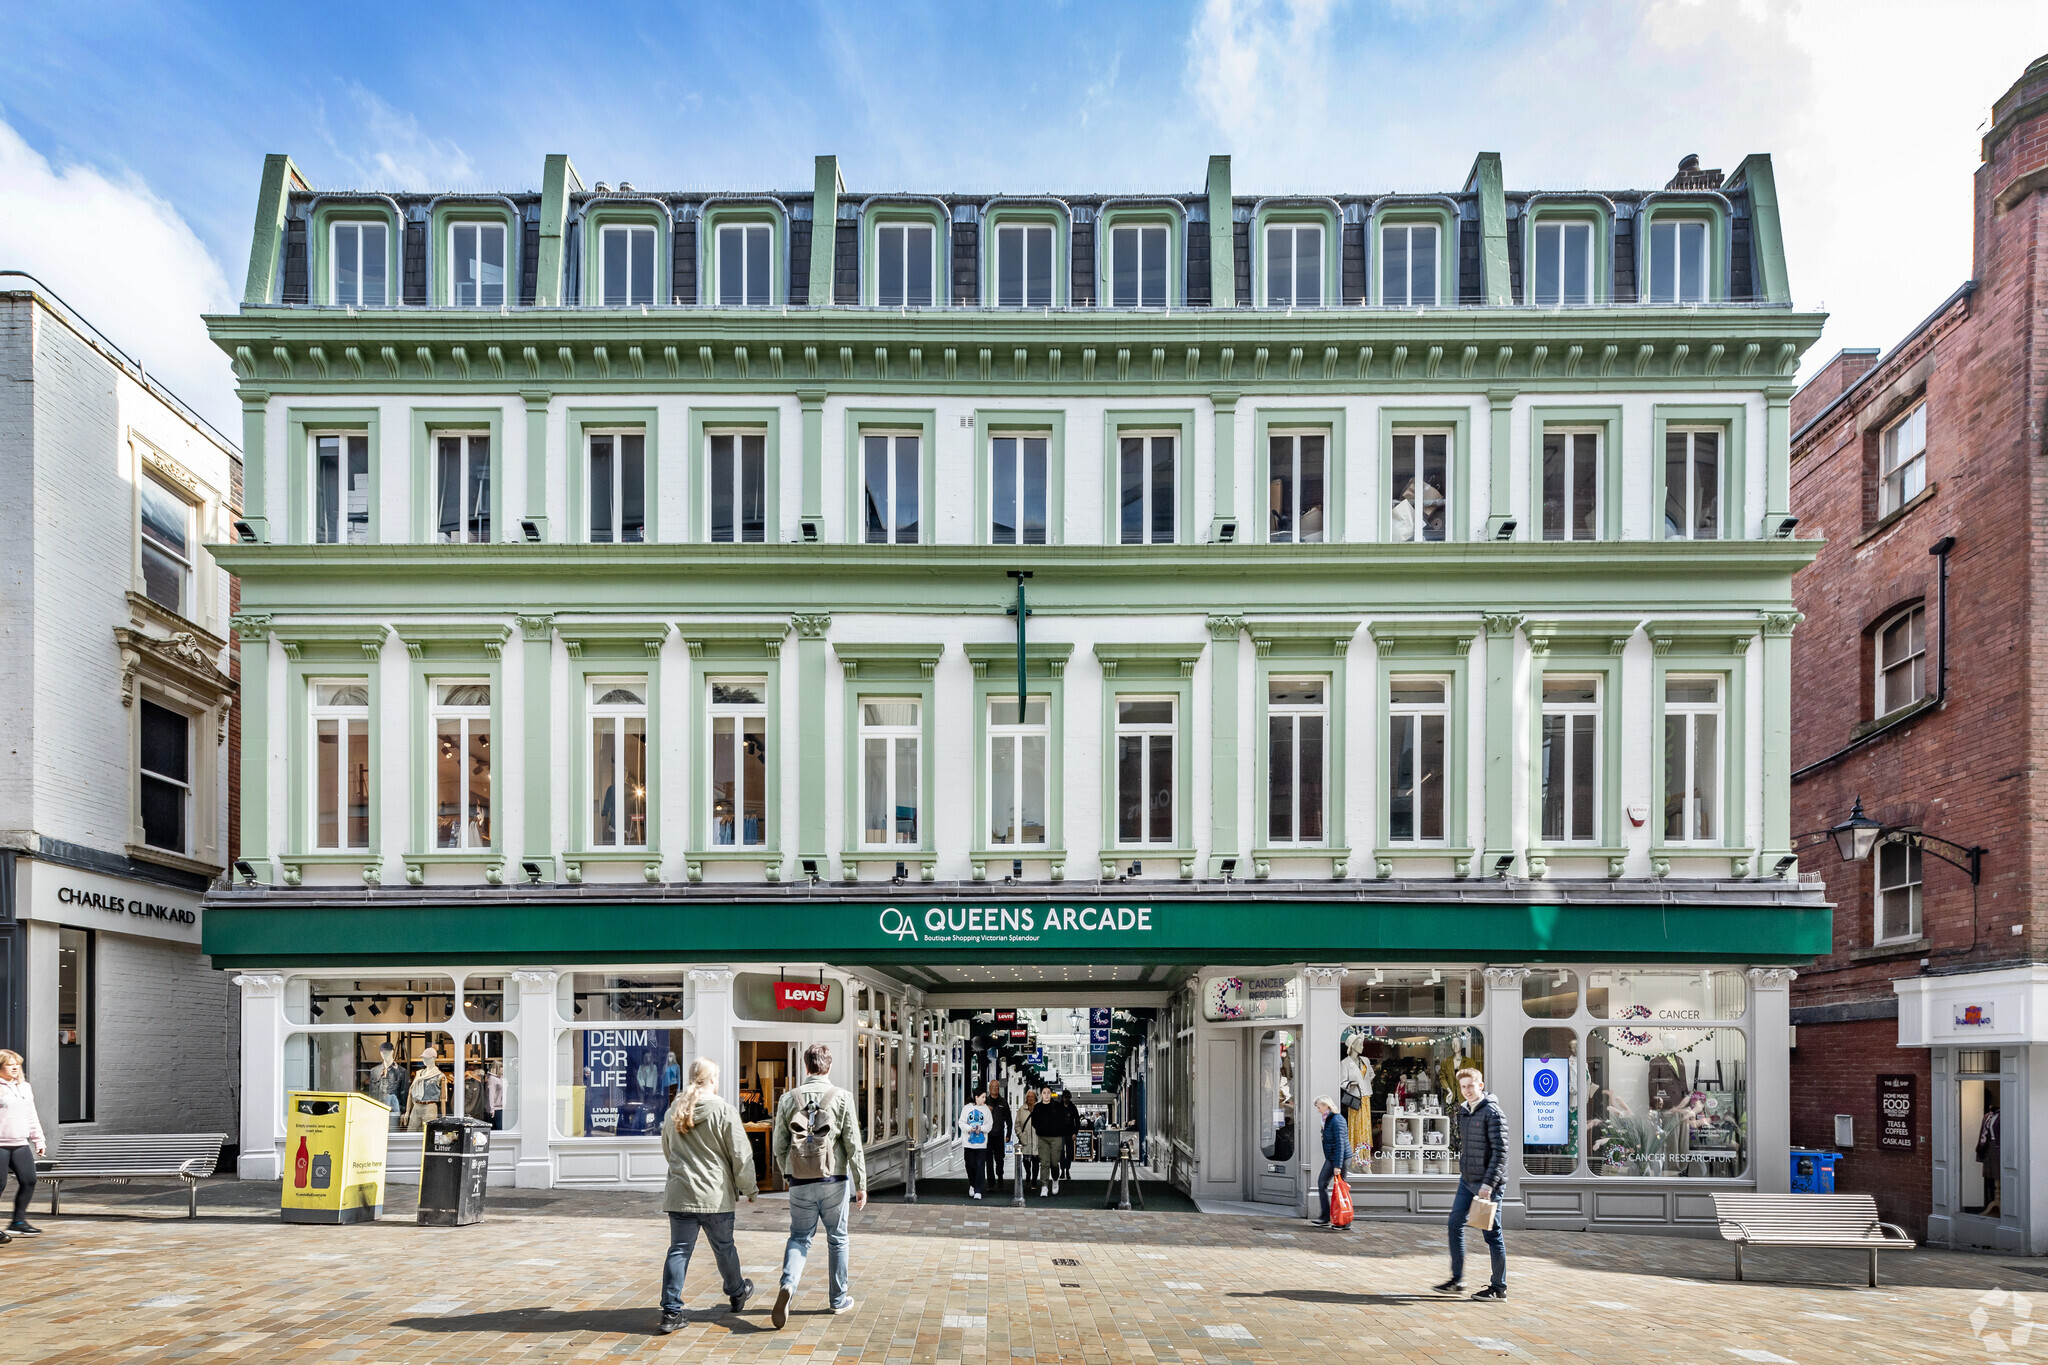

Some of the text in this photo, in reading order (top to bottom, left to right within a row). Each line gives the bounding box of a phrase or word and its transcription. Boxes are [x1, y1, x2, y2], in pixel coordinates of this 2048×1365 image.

[58, 887, 196, 924] CHARLES CLINKARD
[924, 907, 1152, 931] QUEENS ARCADE
[924, 934, 951, 942] Boutique
[952, 934, 980, 943] Shopping
[1009, 934, 1040, 942] Splendour
[1249, 977, 1285, 990] CANCER
[1248, 988, 1294, 1001] RESEARCH
[1249, 1002, 1261, 1013] UK
[1659, 1010, 1700, 1020] CANCER
[591, 1030, 648, 1047] DENIM
[591, 1050, 628, 1067] FOR
[591, 1071, 627, 1087] LIFE
[1883, 1099, 1910, 1110] FOOD
[1885, 1128, 1909, 1136] COFFEES
[1882, 1137, 1912, 1147] CASK ALES
[1374, 1150, 1461, 1160] CANCER RESEARCH
[1628, 1153, 1732, 1163] CANCER RESEARCH UK
[352, 1161, 371, 1169] Recycle
